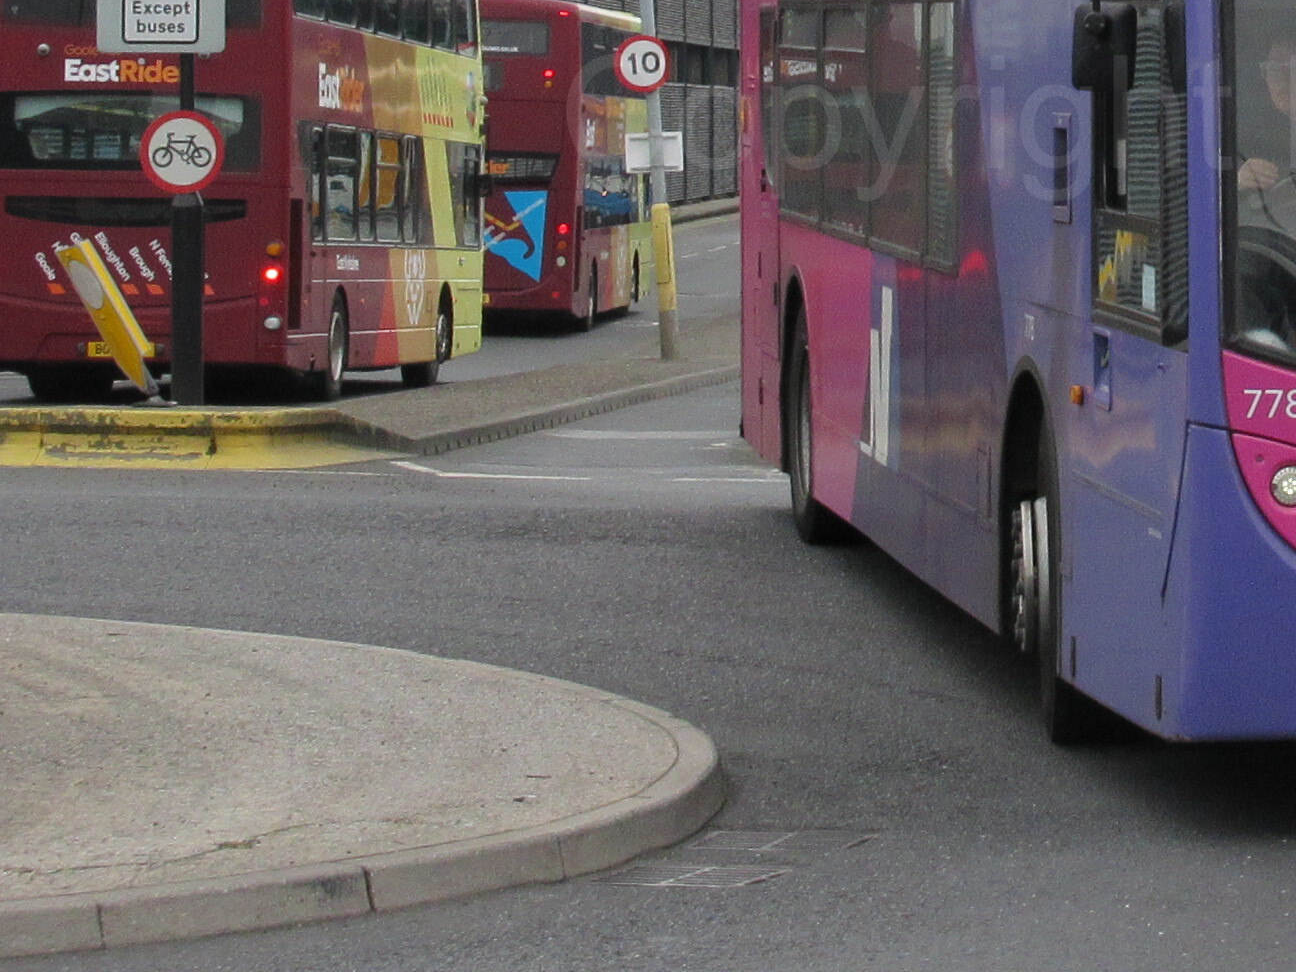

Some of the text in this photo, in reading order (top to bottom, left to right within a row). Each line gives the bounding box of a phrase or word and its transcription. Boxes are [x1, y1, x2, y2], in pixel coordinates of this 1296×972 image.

[132, 0, 191, 17] Except
[136, 19, 186, 34] buses
[64, 57, 180, 83] EastRide
[626, 50, 661, 76] 10
